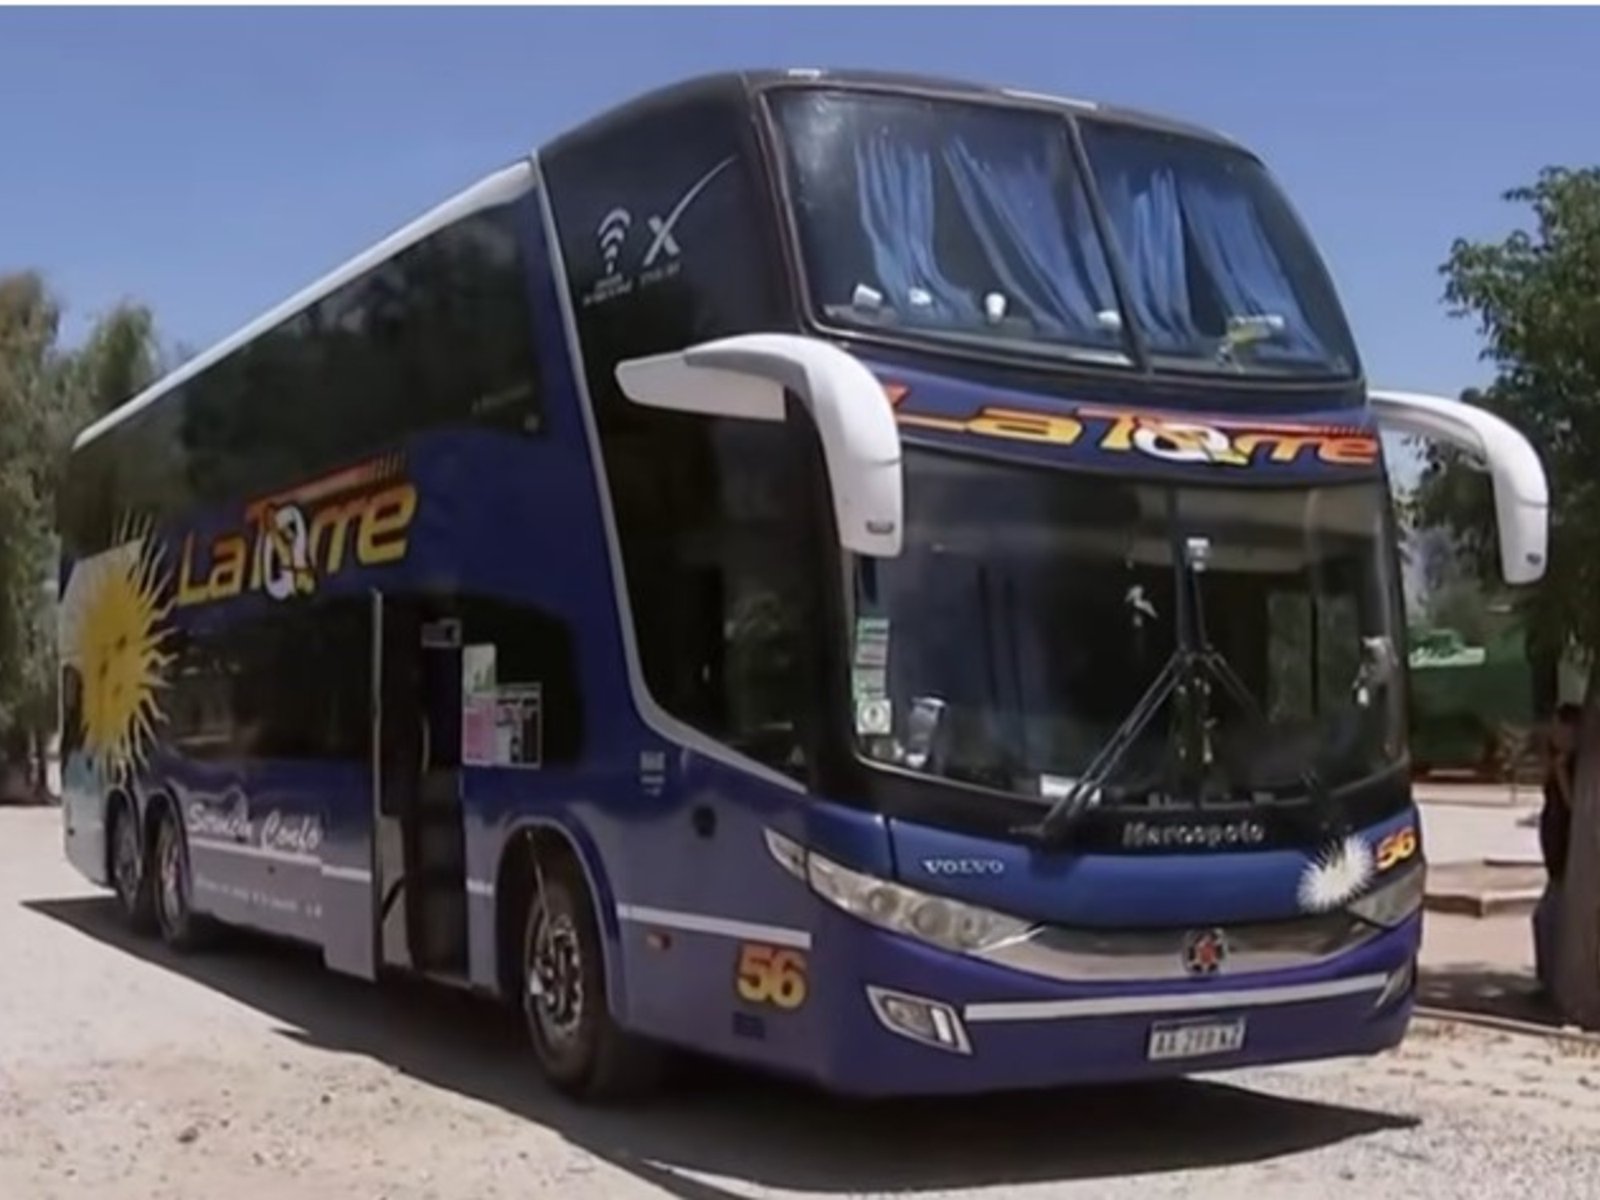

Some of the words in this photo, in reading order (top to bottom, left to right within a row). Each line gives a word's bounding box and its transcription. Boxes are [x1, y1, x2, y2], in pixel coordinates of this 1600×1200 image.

[923, 859, 1004, 876] VOLVO
[1376, 826, 1417, 871] 56
[735, 943, 808, 1010] 56
